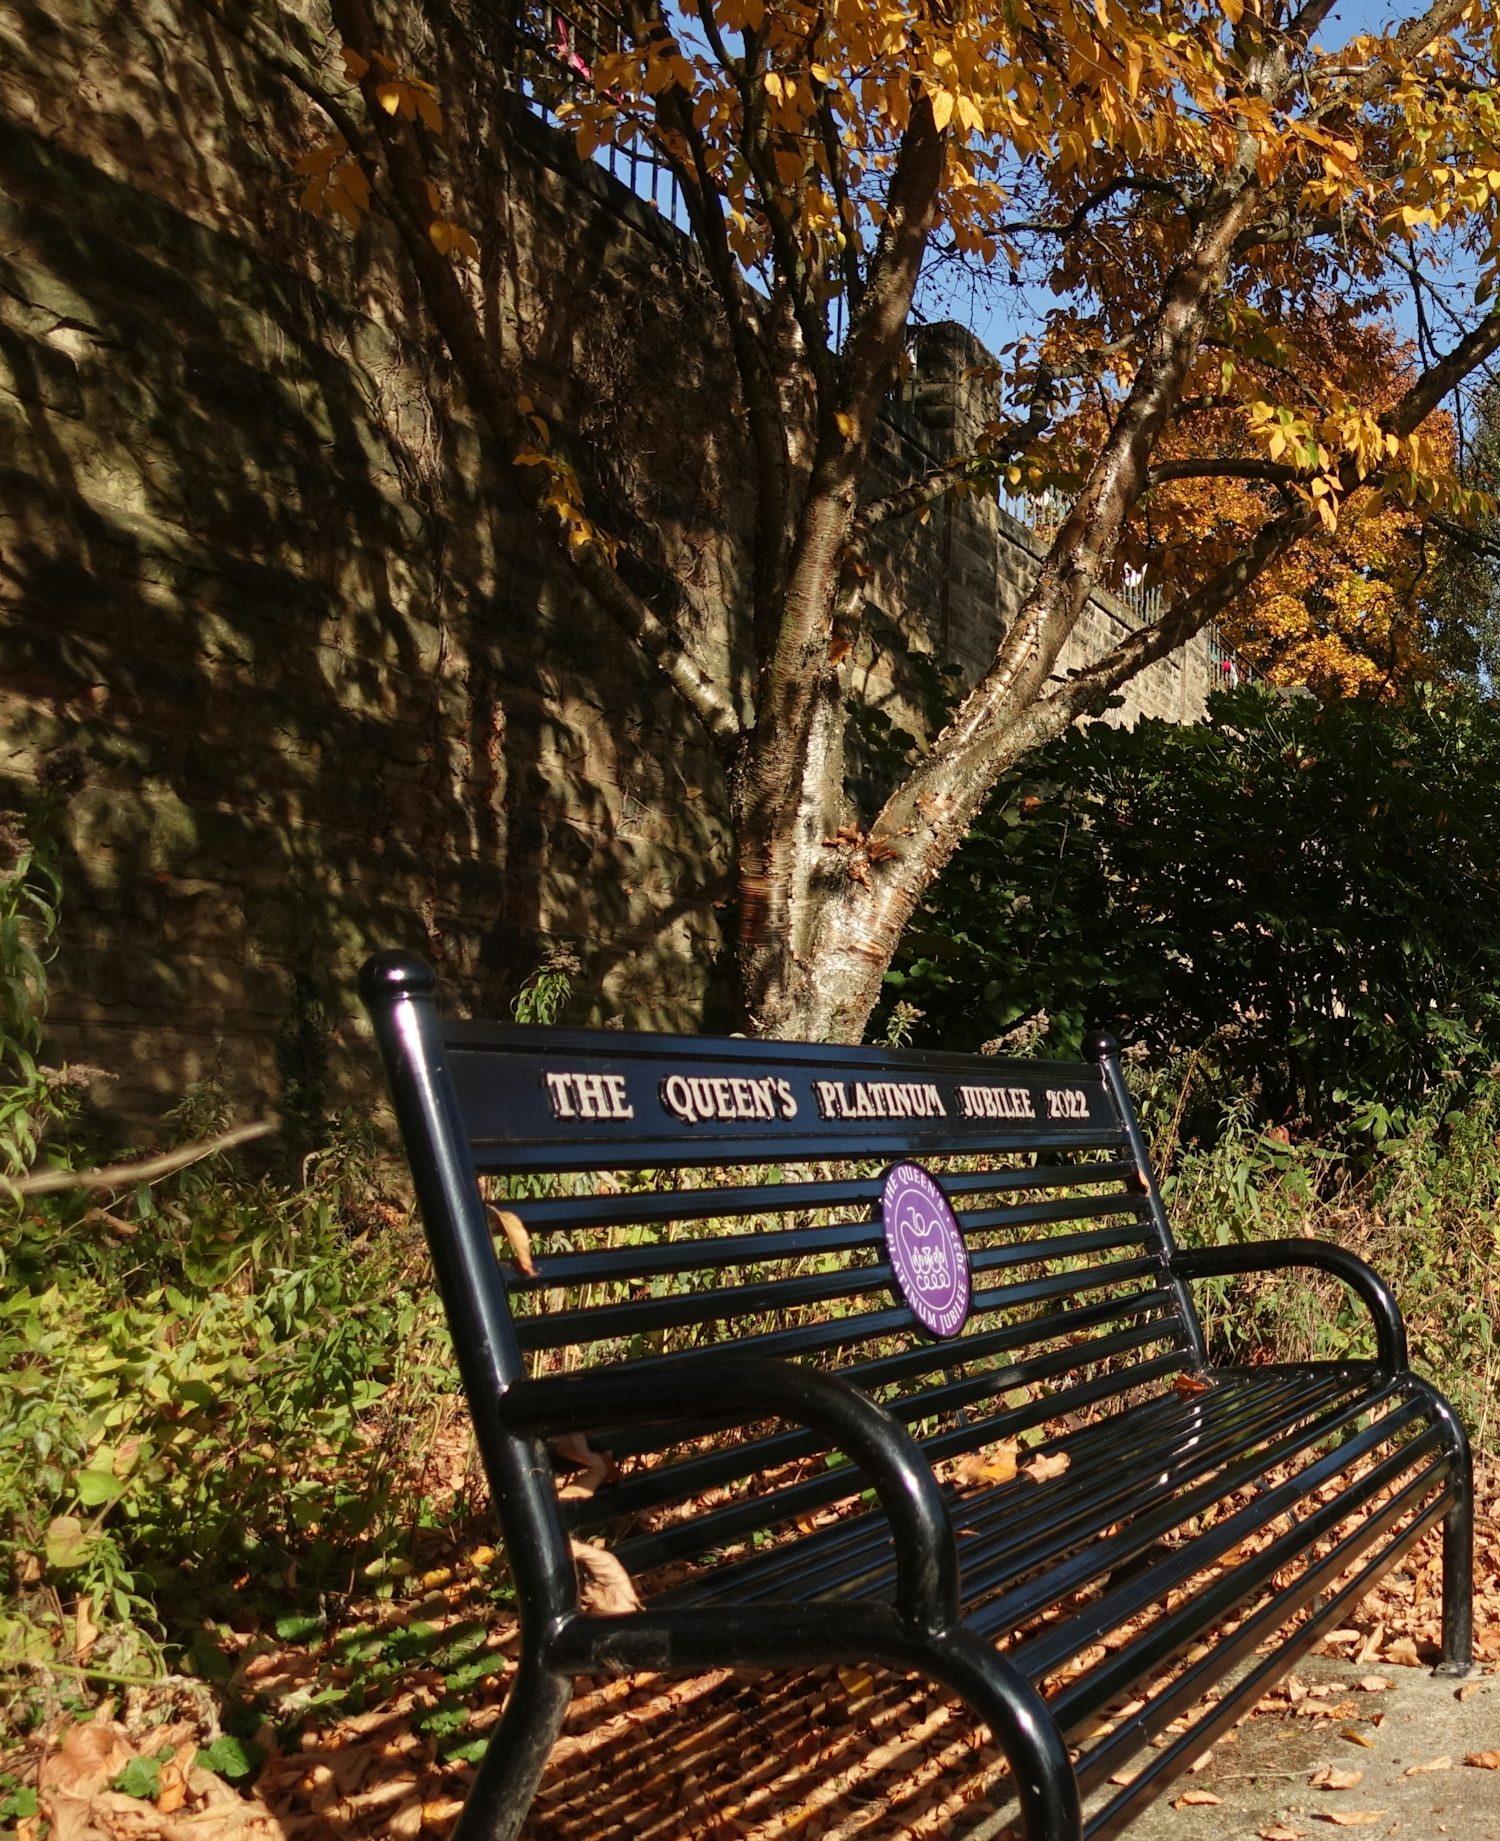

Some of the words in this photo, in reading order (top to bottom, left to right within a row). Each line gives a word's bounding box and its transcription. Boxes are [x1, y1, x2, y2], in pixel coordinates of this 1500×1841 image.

[545, 1072, 634, 1119] THE
[663, 1075, 798, 1124] QUEEN'S
[817, 1080, 946, 1119] PLATINUM
[958, 1085, 1036, 1119] JUBILEE
[1046, 1089, 1090, 1119] 2022
[884, 1175, 898, 1209] THE
[898, 1165, 945, 1211] QUEEN'S
[950, 1230, 965, 1274] 2022
[885, 1233, 937, 1329] PLATINUM
[939, 1280, 967, 1334] JUBILEE
